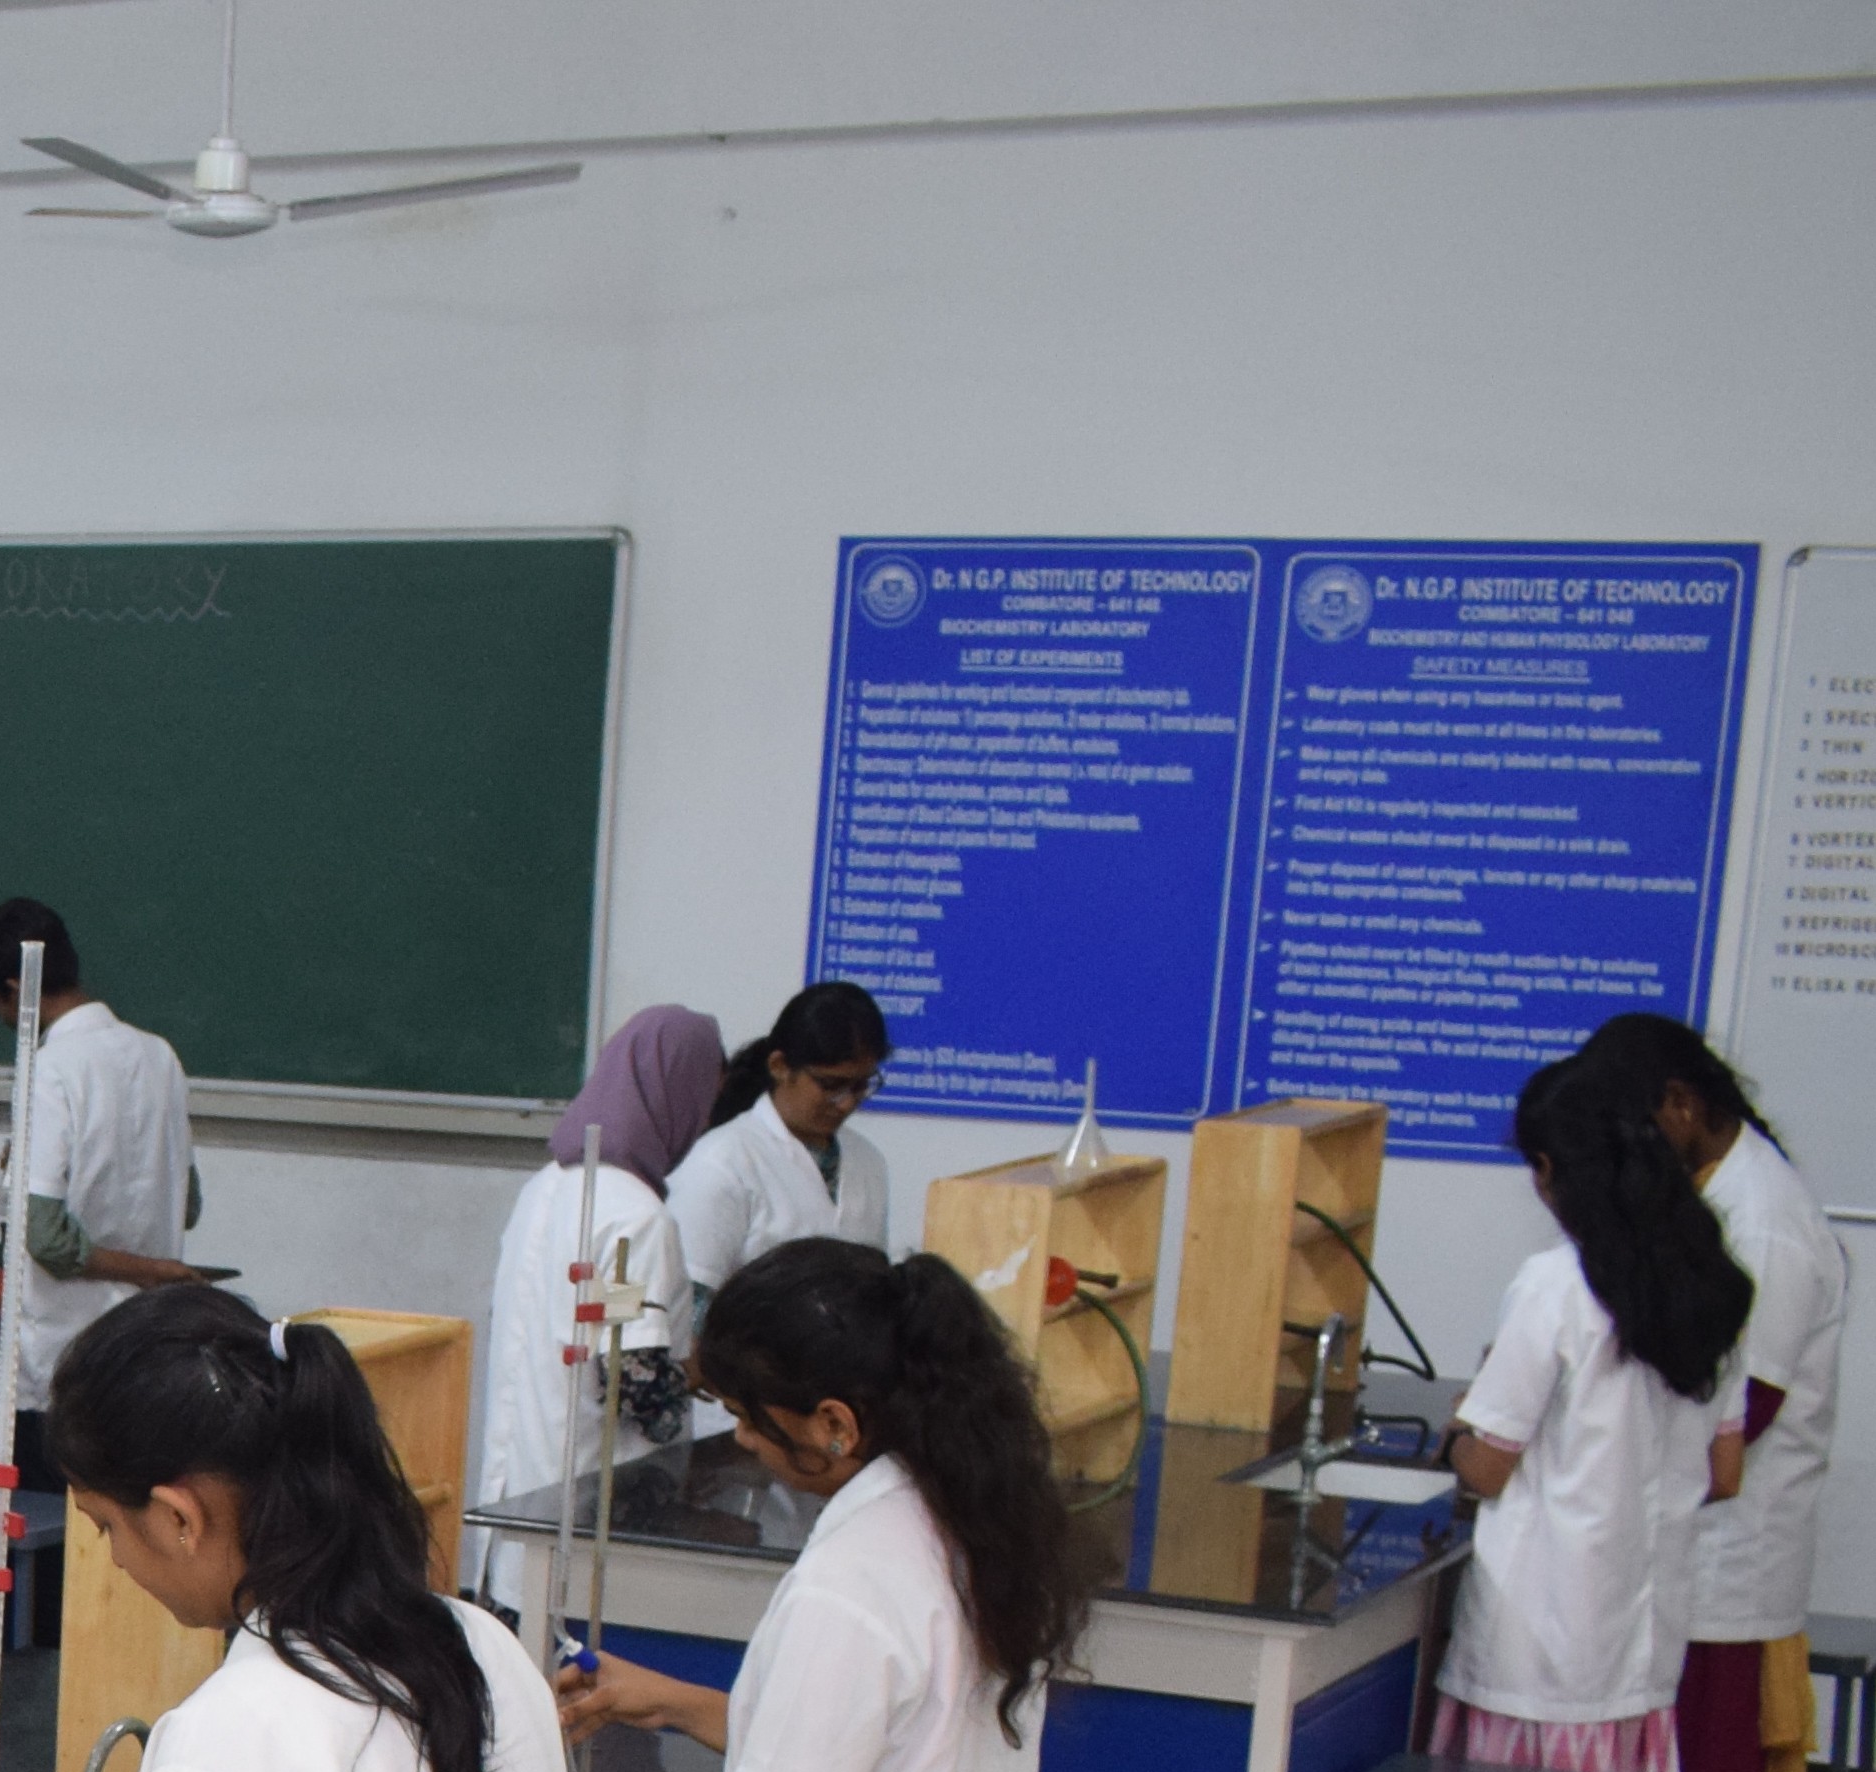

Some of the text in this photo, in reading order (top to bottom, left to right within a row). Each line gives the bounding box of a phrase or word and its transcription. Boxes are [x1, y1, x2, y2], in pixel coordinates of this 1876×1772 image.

[1009, 568, 1098, 592] INSTITUTE
[1101, 569, 1125, 591] OF
[1130, 569, 1251, 594] TECHNOLOGY
[1375, 575, 1398, 599] Dr.
[1461, 577, 1559, 602] INSTITUTE
[1562, 578, 1590, 602] OF
[1595, 579, 1729, 605] TECHNOLOGY
[1001, 595, 1095, 613] COIMBATORE
[1459, 605, 1562, 624] COIMBATORE
[939, 618, 1150, 638] BIOCHEMISTRY LABORATORY
[1368, 628, 1710, 651] BIOCHEMISTRY AND HUMAN PHYSIOLOGY LABORATORY
[960, 648, 1124, 667] LIST OF EXPERIMENTS
[1412, 655, 1589, 676] SAFETY MEASURES
[1807, 831, 1875, 848] VORTEX
[1805, 853, 1875, 871] DIGITAL
[1799, 886, 1871, 902] DIGITAL
[1798, 914, 1876, 933] REFRIGE
[1794, 942, 1876, 960] MICROSC
[1793, 976, 1846, 994] ELISA
